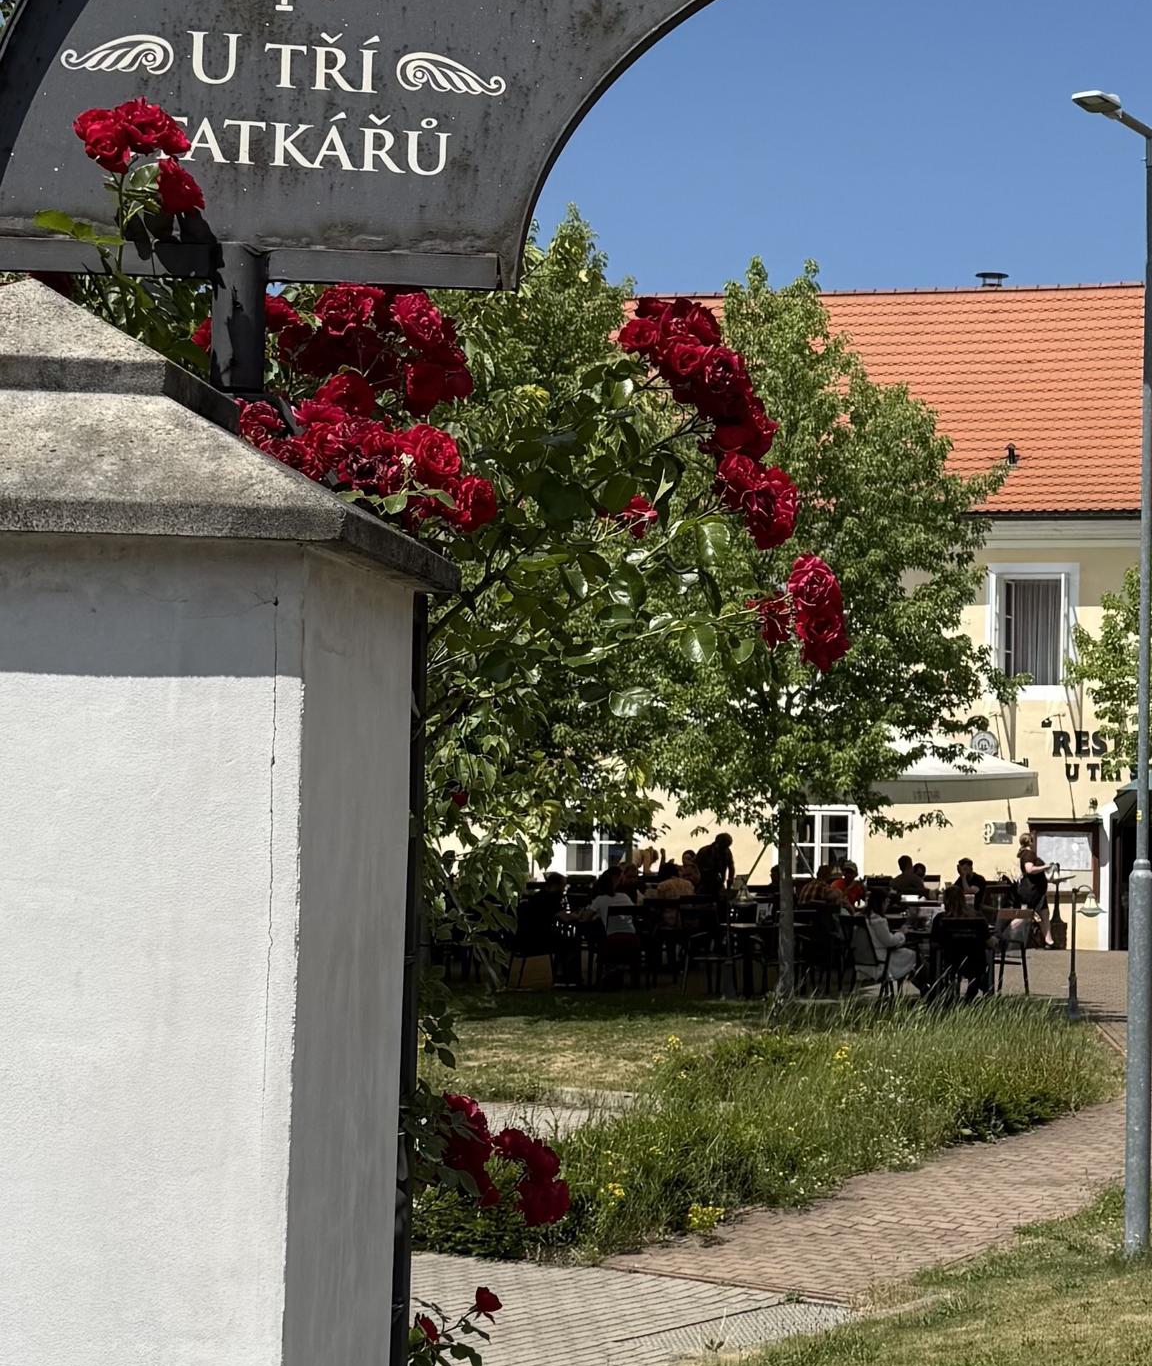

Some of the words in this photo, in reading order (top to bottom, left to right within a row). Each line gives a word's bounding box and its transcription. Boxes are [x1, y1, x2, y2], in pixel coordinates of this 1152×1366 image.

[187, 30, 242, 85] U
[264, 32, 381, 94] TŘÍ
[156, 112, 452, 176] ATKÁŘŮ
[1065, 763, 1080, 782] U
